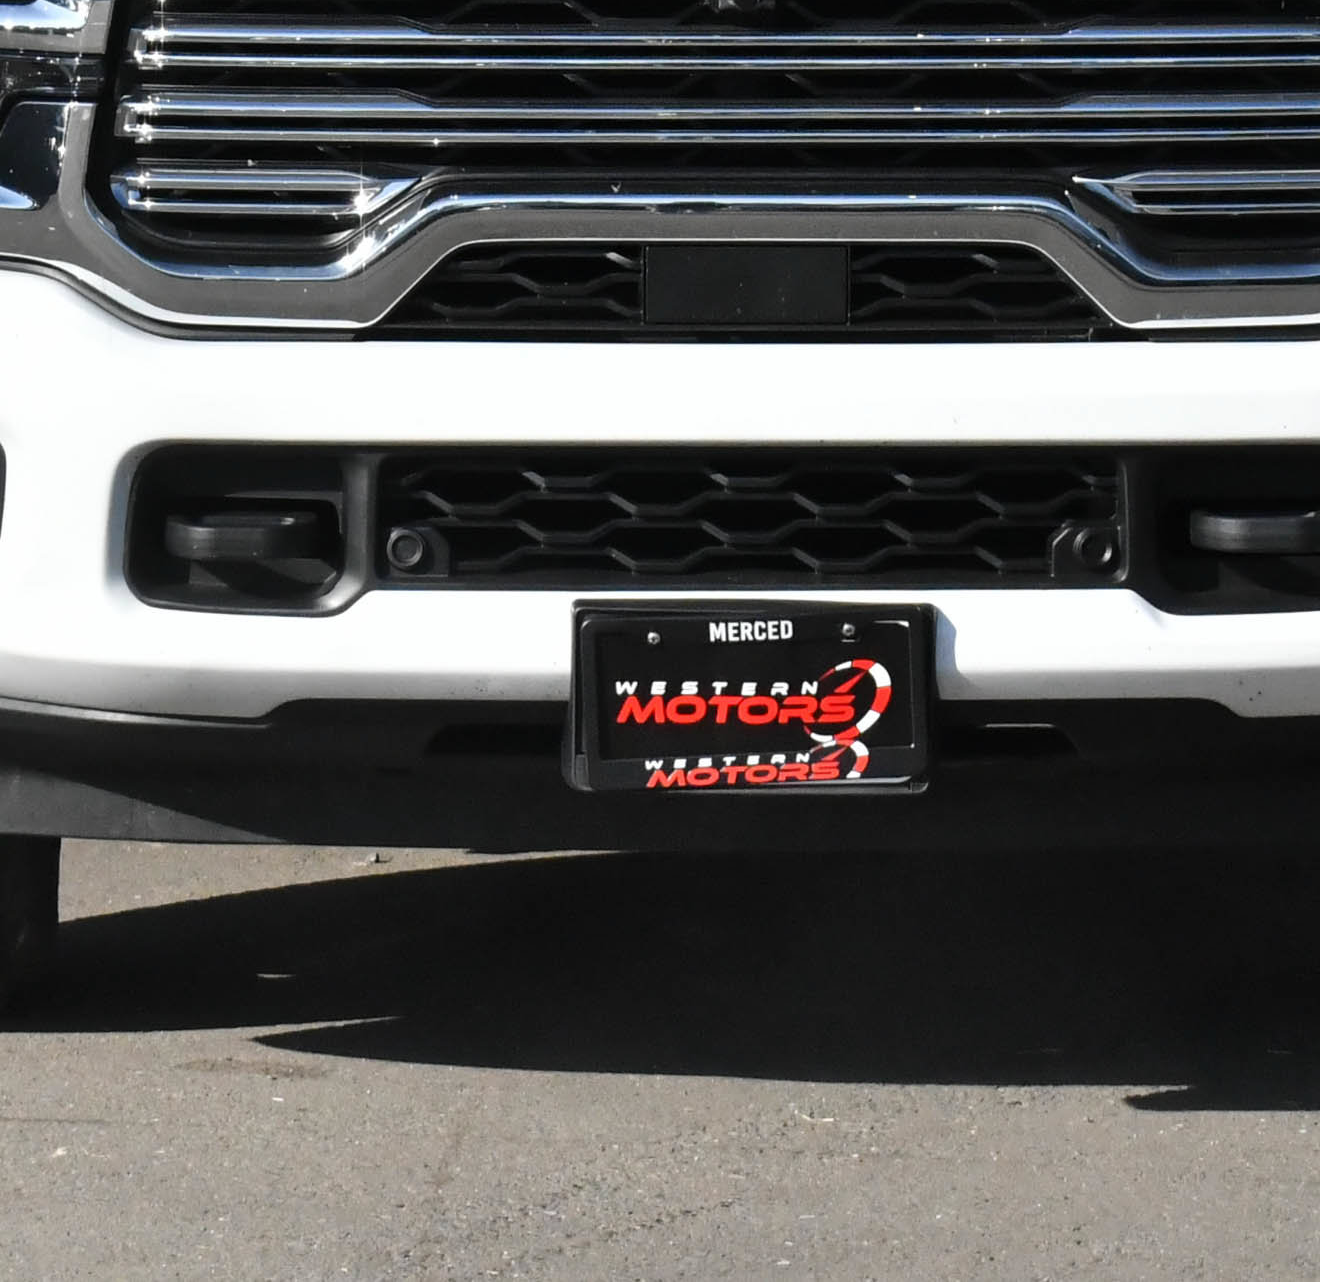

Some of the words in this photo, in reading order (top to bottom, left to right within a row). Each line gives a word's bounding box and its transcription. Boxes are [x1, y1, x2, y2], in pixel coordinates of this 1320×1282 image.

[709, 620, 793, 642] MERCED
[615, 681, 818, 695] WESTERN
[616, 695, 856, 724] MOTORS
[645, 753, 811, 770] WESTERN
[646, 761, 841, 788] MOTORS
